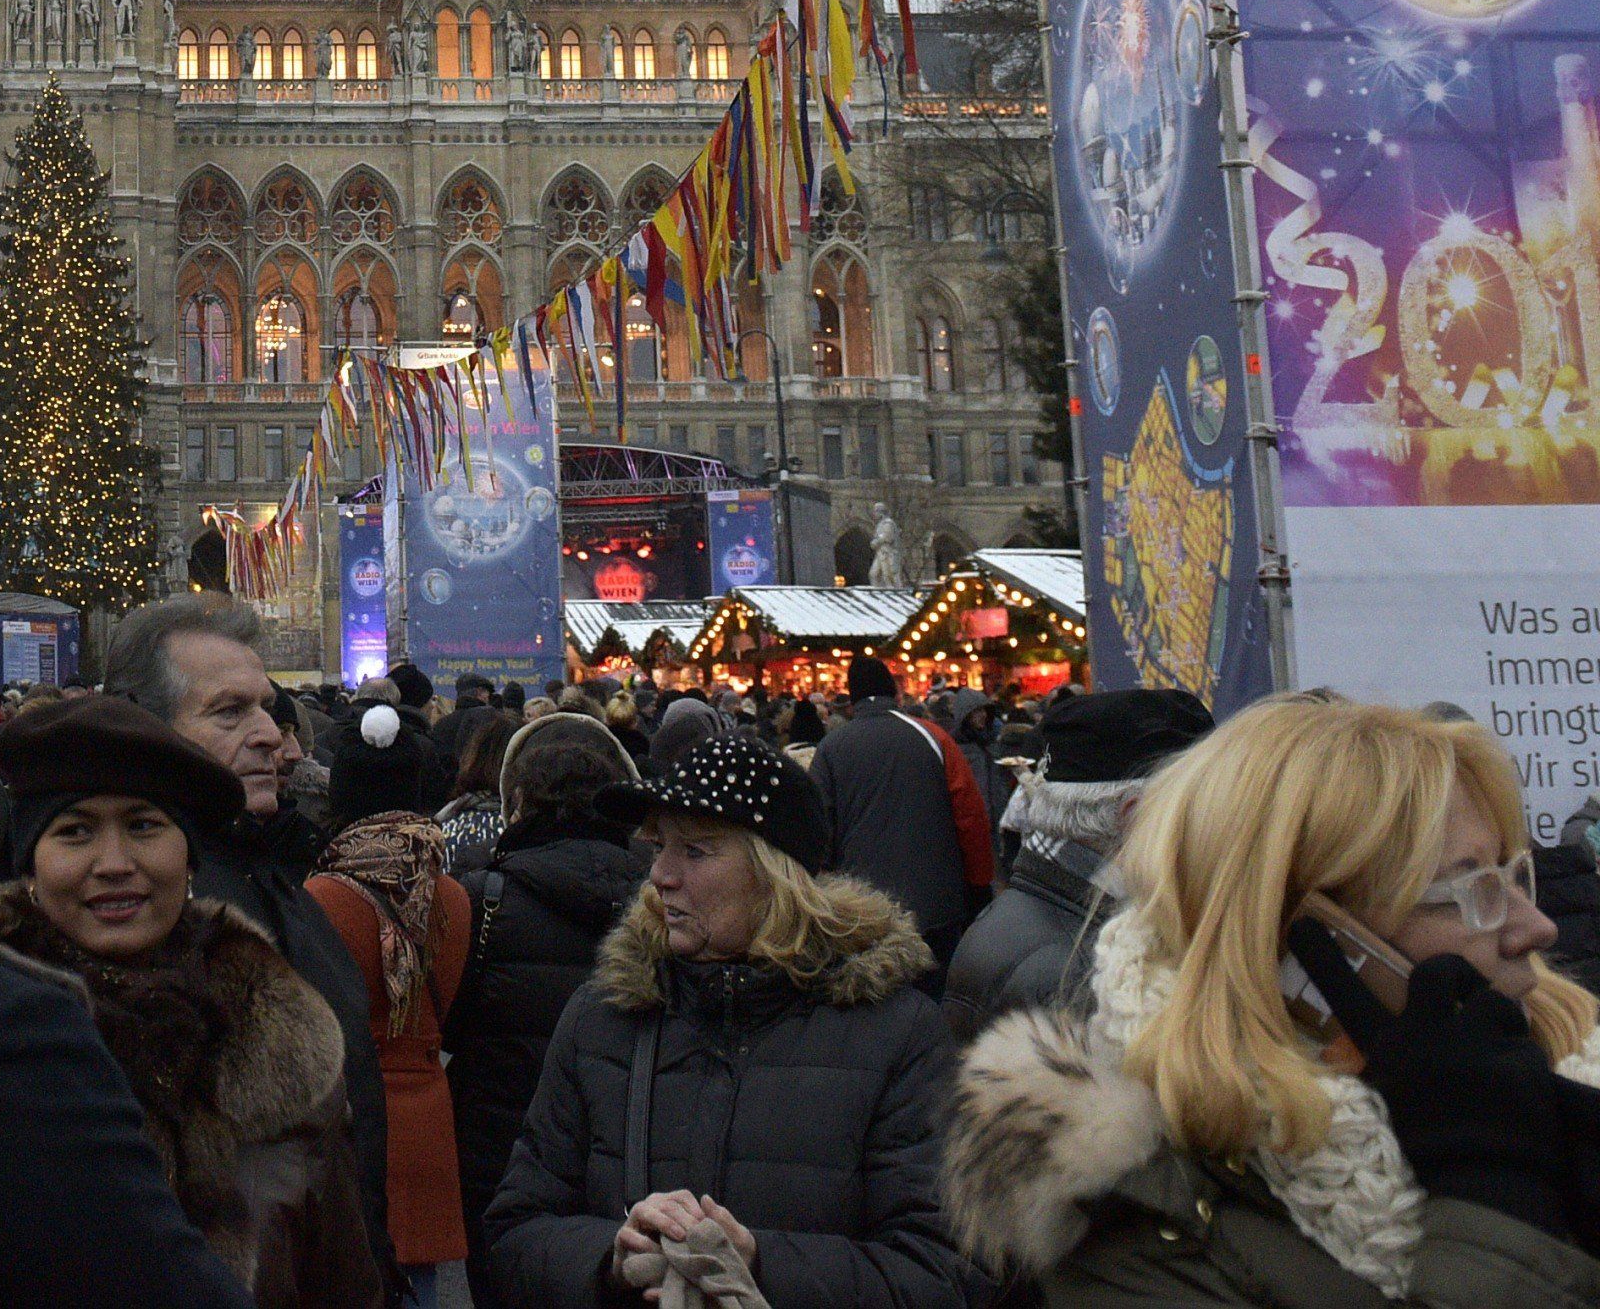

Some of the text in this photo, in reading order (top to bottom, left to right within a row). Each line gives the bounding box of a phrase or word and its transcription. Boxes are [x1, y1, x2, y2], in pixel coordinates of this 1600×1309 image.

[727, 560, 756, 568] RADIO
[357, 578, 379, 586] WIEN
[602, 587, 638, 598] WIEN
[1479, 601, 1559, 635] Was
